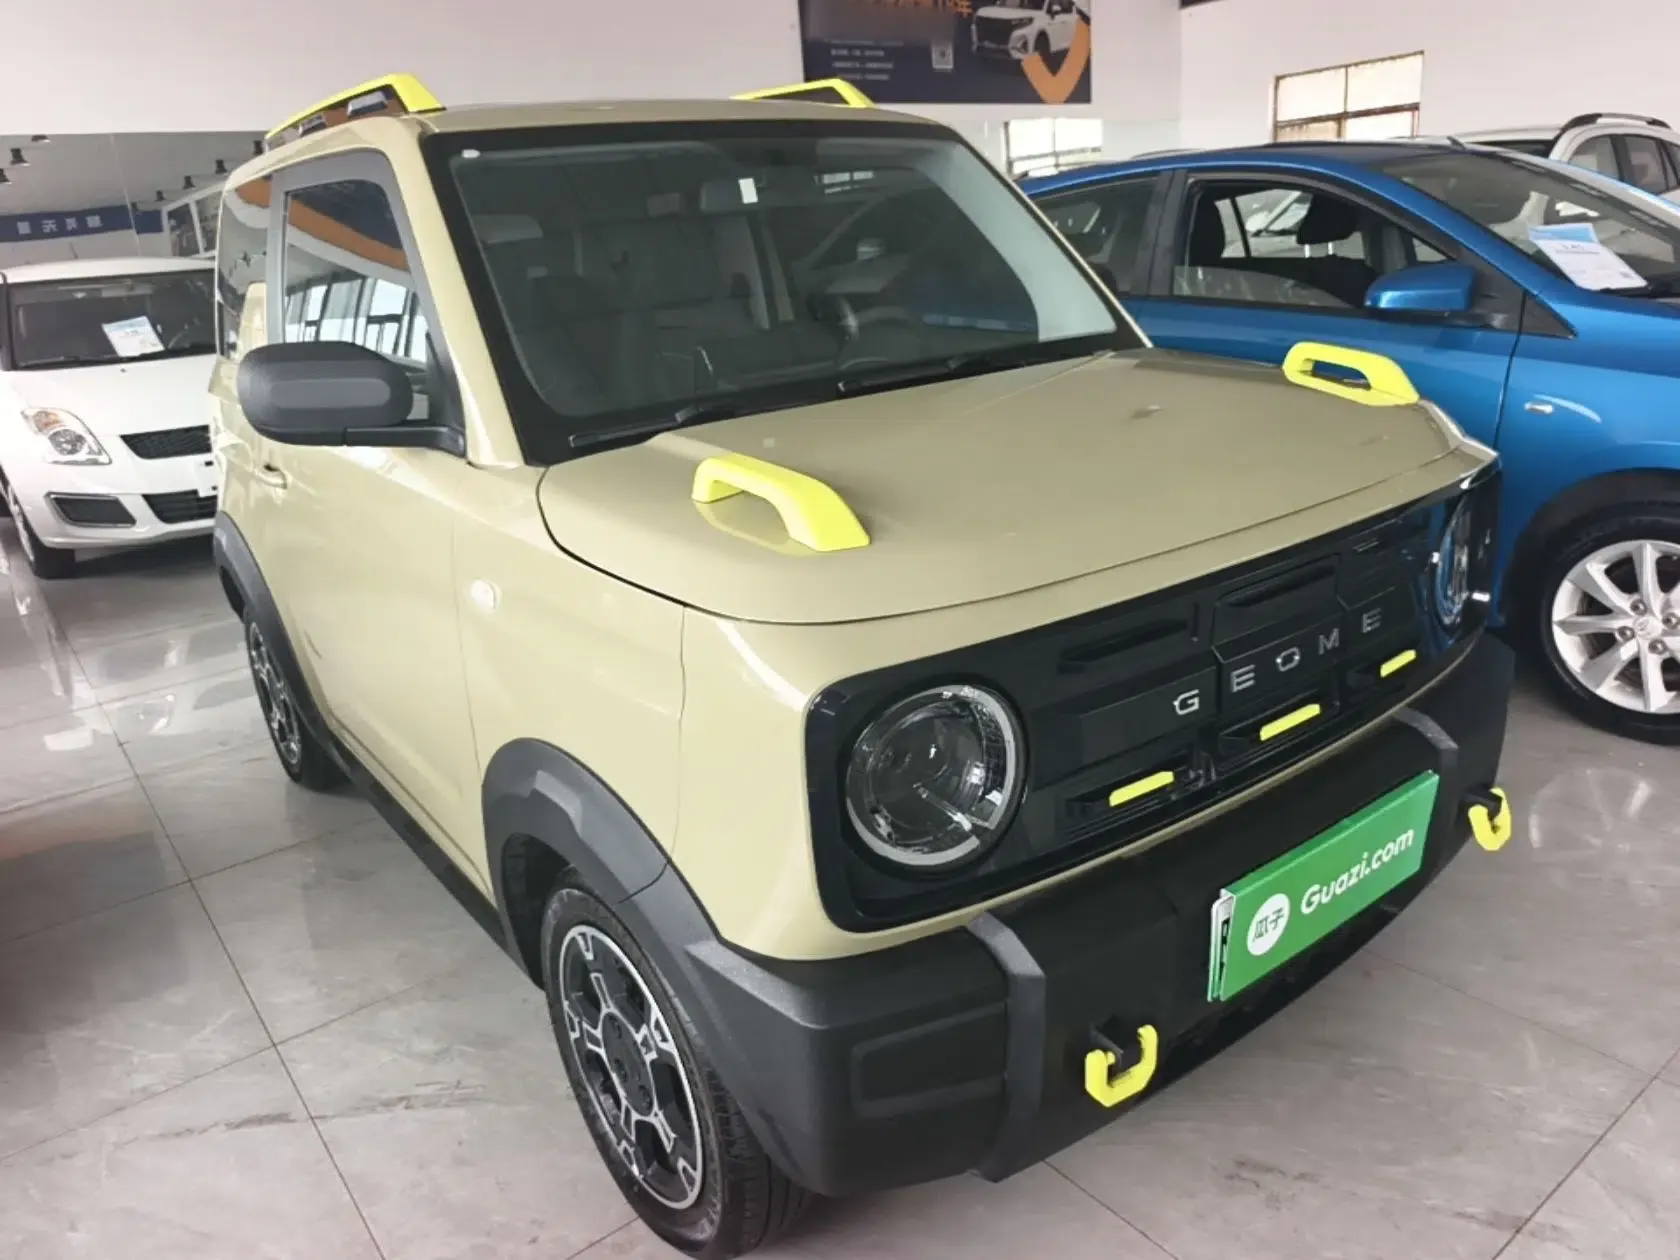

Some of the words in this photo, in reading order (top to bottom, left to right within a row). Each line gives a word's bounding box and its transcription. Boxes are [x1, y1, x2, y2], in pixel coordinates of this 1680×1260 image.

[1173, 608, 1381, 715] GEOME
[1301, 829, 1415, 914] Guazi.com
[1252, 907, 1284, 942] 瓜子
